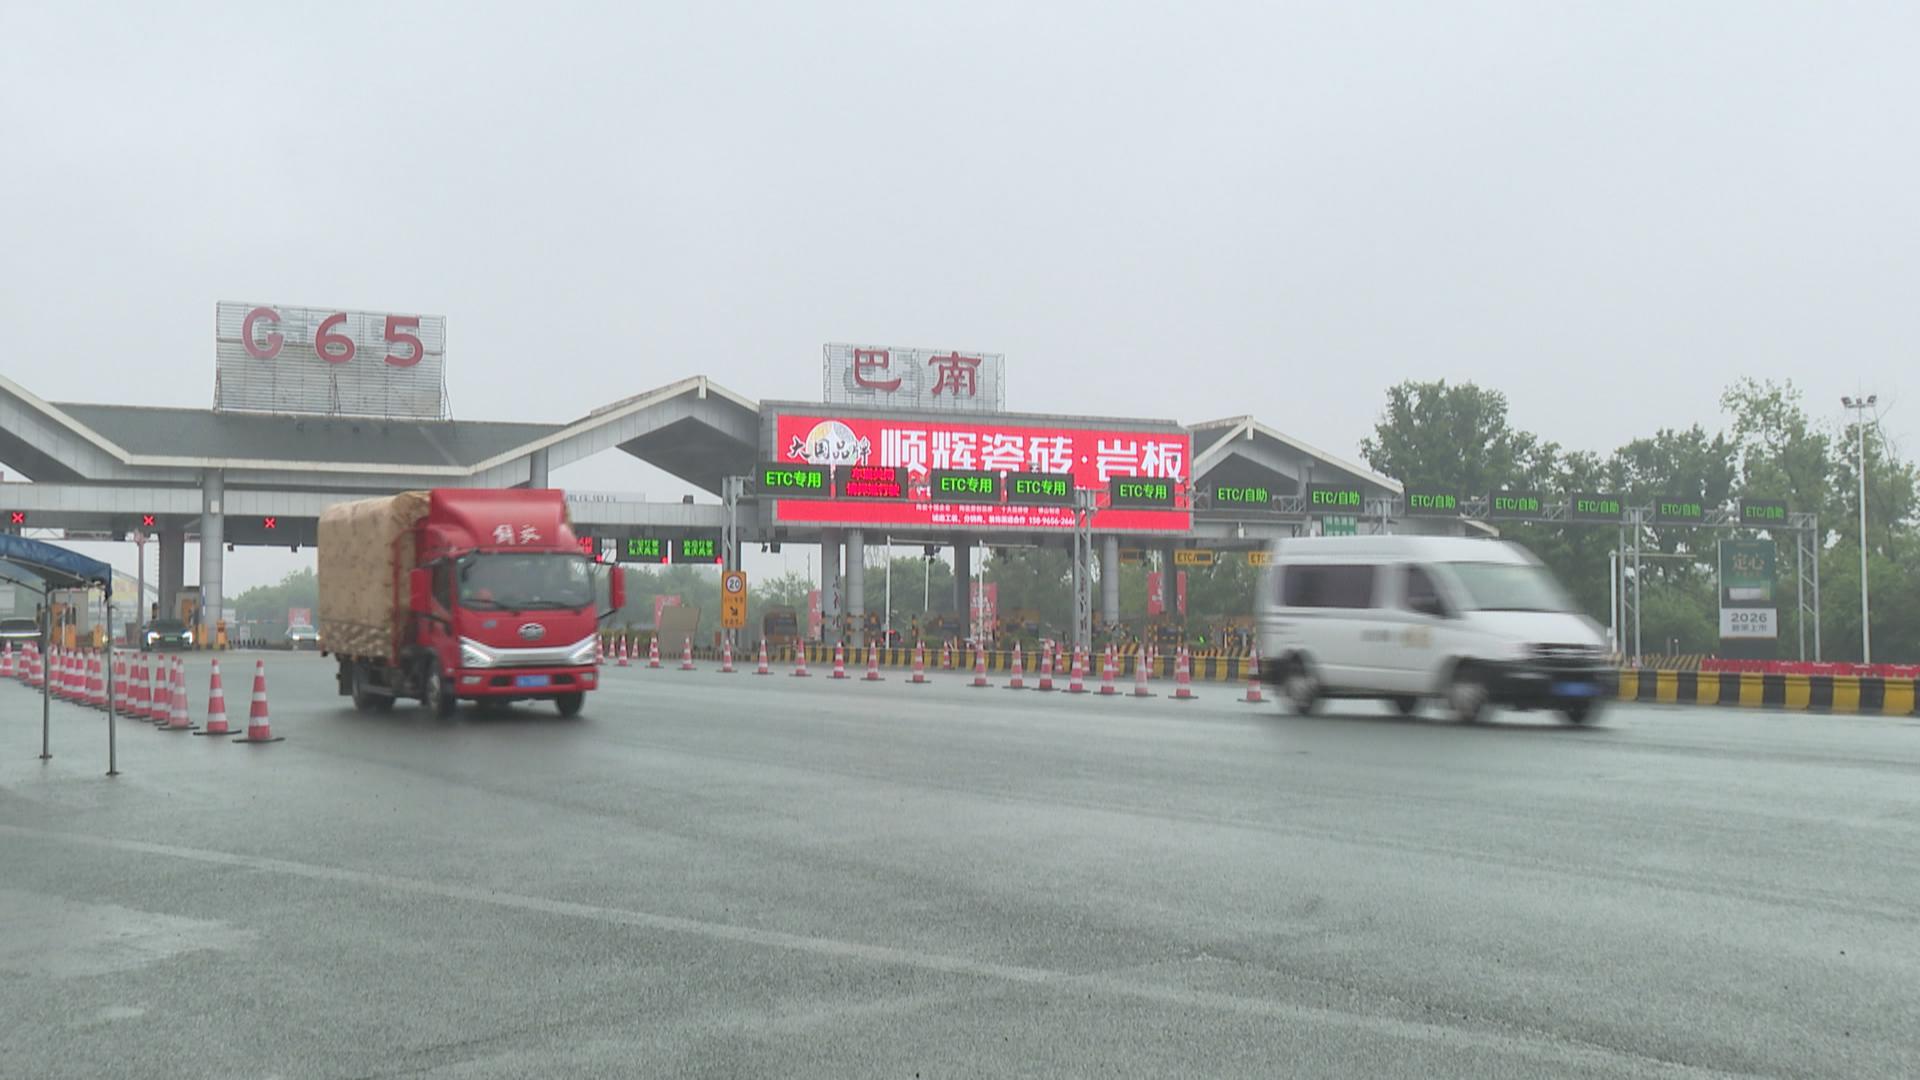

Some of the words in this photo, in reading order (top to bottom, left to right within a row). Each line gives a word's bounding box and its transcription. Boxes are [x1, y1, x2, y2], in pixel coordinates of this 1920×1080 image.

[242, 306, 424, 367] G65
[853, 348, 982, 396] 巴南
[787, 435, 871, 467] 大国品牌
[765, 470, 822, 488] ETC专用
[941, 476, 993, 493] ETC专用
[1016, 479, 1066, 495] ETC专用
[1119, 483, 1167, 498] ETC专用
[1217, 487, 1268, 502] ETC/自助
[1312, 491, 1359, 505] ETC/自助
[1411, 495, 1455, 509] ETC/自助
[1496, 498, 1538, 510] ETC/自助
[1578, 500, 1619, 513] ETC/自助
[1661, 503, 1700, 516] ETC/自助
[1745, 506, 1784, 518] ETC/自助
[729, 578, 741, 590] 20
[1730, 612, 1768, 623] 2026
